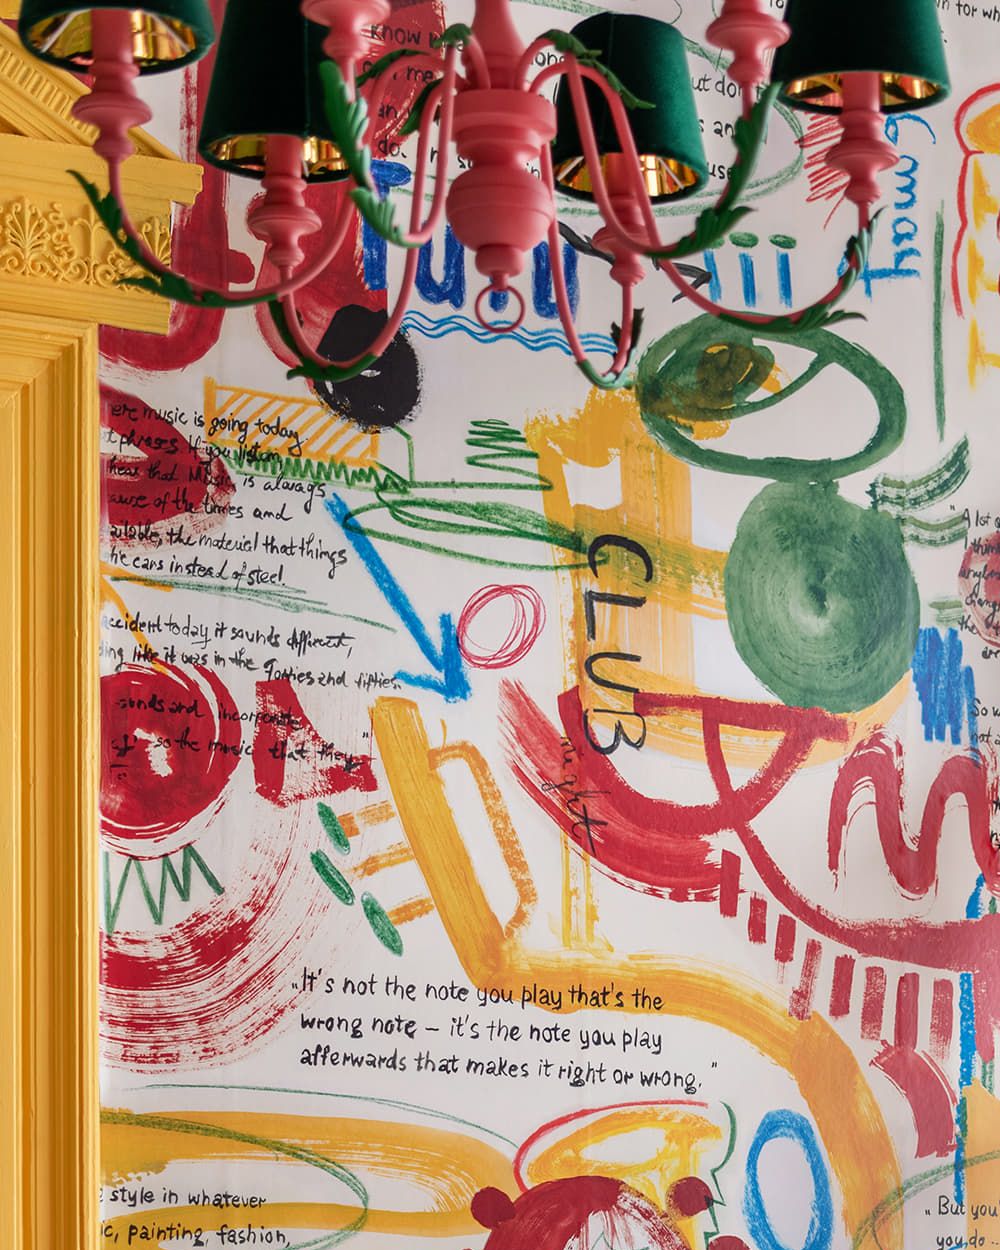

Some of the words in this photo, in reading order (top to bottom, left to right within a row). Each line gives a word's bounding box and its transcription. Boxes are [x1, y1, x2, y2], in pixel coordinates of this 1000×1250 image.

[955, 2, 978, 17] for
[208, 413, 250, 443] going
[252, 502, 294, 522] and
[169, 556, 229, 580] instead
[584, 534, 653, 755] CLUB
[342, 976, 379, 998] not
[385, 976, 417, 1001] the
[425, 980, 470, 1004] note
[476, 986, 515, 1009] you
[521, 984, 563, 1011] play
[568, 982, 626, 1010] that's
[631, 987, 666, 1012] the
[300, 1015, 364, 1039] wrong
[371, 1015, 419, 1039] note
[449, 1015, 481, 1040] it's
[487, 1019, 523, 1042] the
[529, 1021, 571, 1044] note
[579, 1023, 617, 1051] you
[622, 1026, 663, 1056] play
[413, 1050, 460, 1075] that
[466, 1054, 530, 1079] makes
[537, 1057, 554, 1080] it
[558, 1060, 607, 1089] right
[612, 1065, 635, 1084] or
[109, 1184, 156, 1208] style
[162, 1187, 179, 1205] in
[188, 1189, 268, 1210] whatever
[128, 1223, 210, 1248] painting,
[216, 1223, 292, 1248] fashion,
[968, 1233, 987, 1247] do
